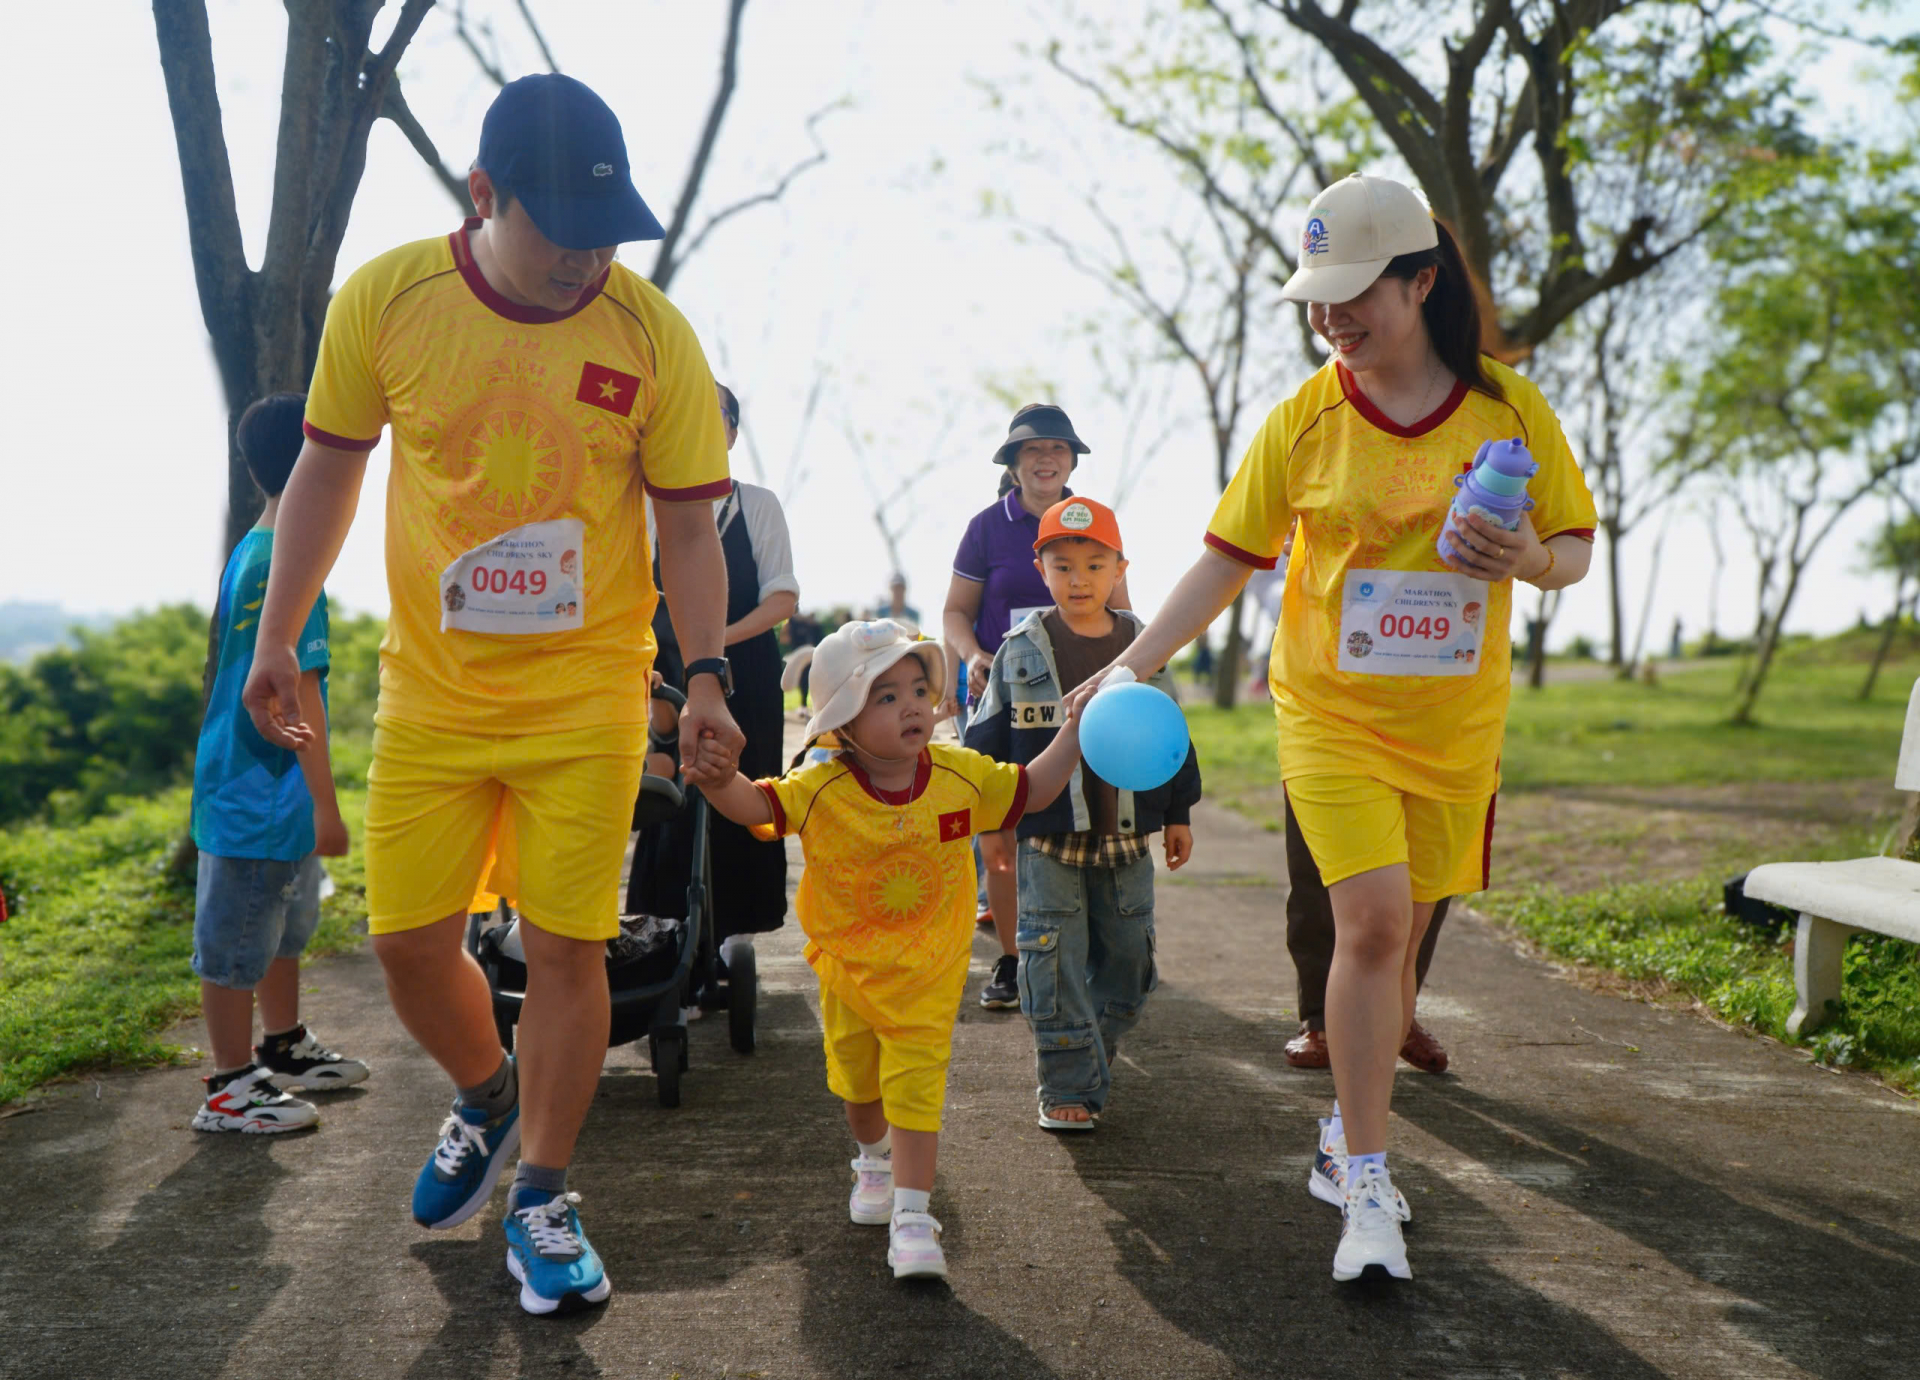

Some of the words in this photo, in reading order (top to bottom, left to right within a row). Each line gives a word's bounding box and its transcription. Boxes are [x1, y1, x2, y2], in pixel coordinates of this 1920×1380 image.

[486, 550, 534, 559] CHILDREN'S
[537, 551, 553, 559] SKY
[471, 566, 547, 595] 0049
[1404, 588, 1452, 598] MARATHON
[1394, 598, 1441, 607] CHILDREN'S
[1443, 600, 1458, 608] SKY
[1379, 614, 1450, 640] 0049
